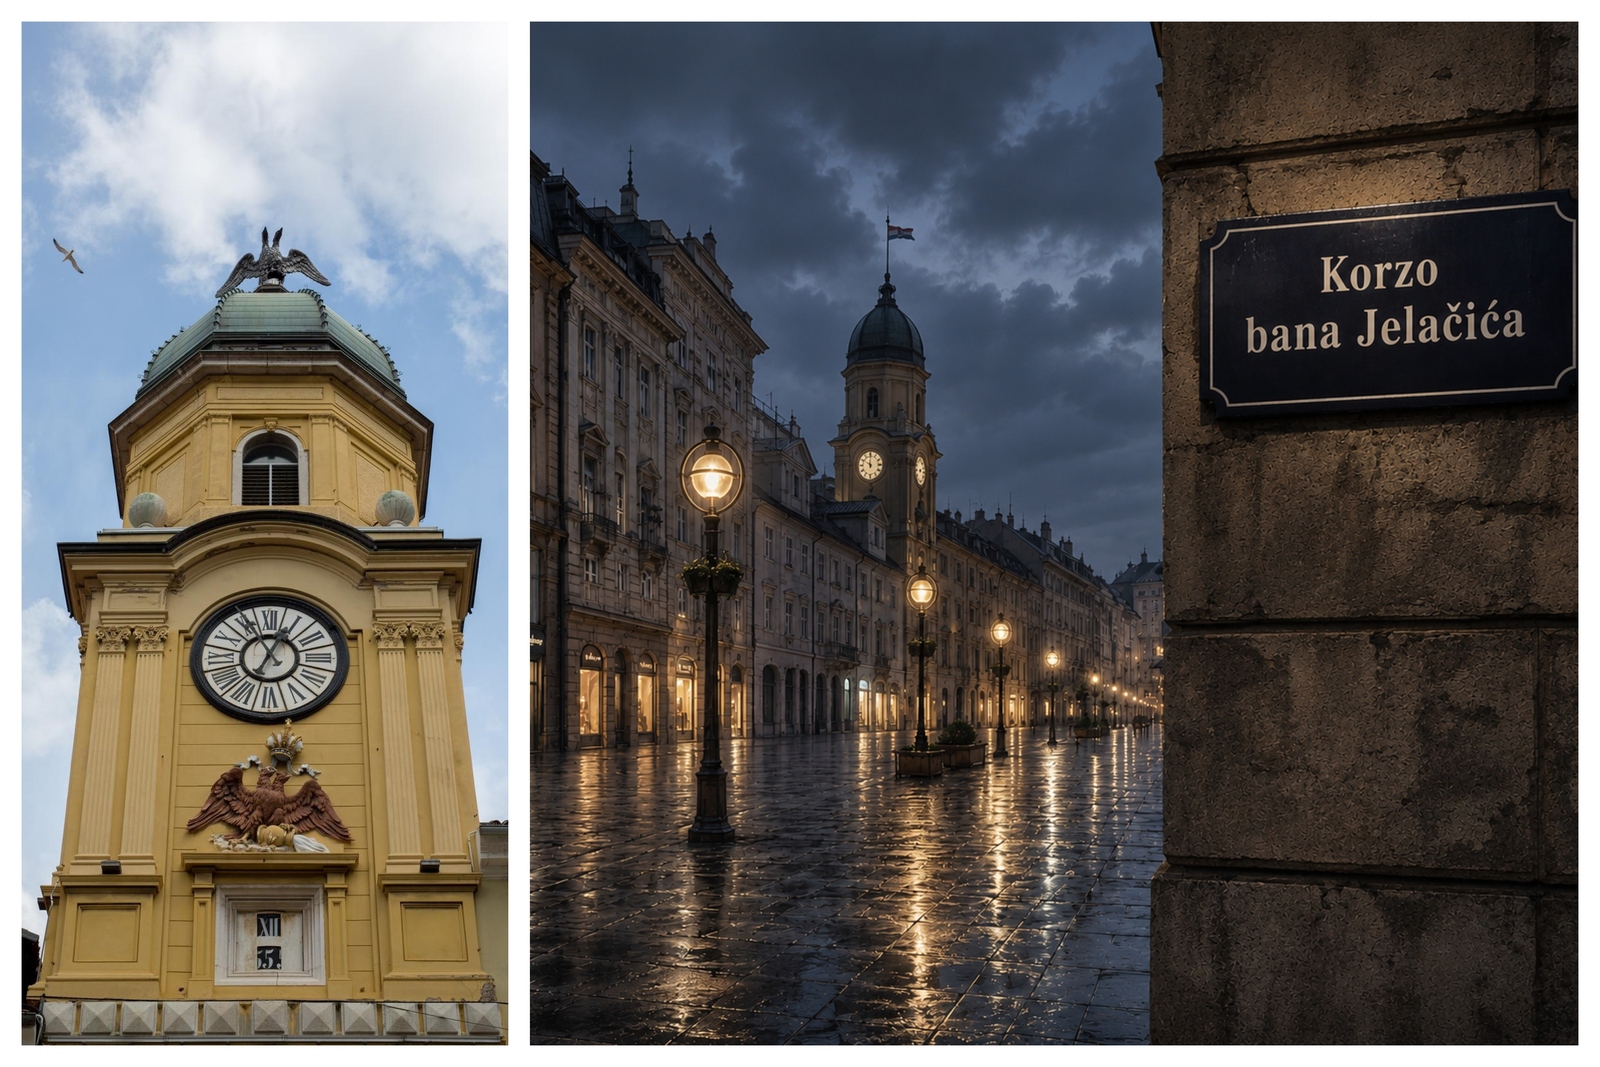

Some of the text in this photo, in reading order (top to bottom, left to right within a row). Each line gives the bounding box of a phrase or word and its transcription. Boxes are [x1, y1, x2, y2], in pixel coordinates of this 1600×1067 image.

[1320, 254, 1439, 293] Korzo
[1245, 299, 1526, 354] bana Jelačića
[261, 610, 278, 631] XII
[287, 615, 303, 635] I
[214, 630, 242, 647] X
[298, 630, 325, 647] II
[208, 651, 235, 665] IX
[305, 652, 332, 664] III
[300, 668, 327, 688] IV
[230, 680, 256, 705] VII
[261, 686, 279, 709] VI
[287, 682, 307, 704] V
[258, 917, 279, 937] XII
